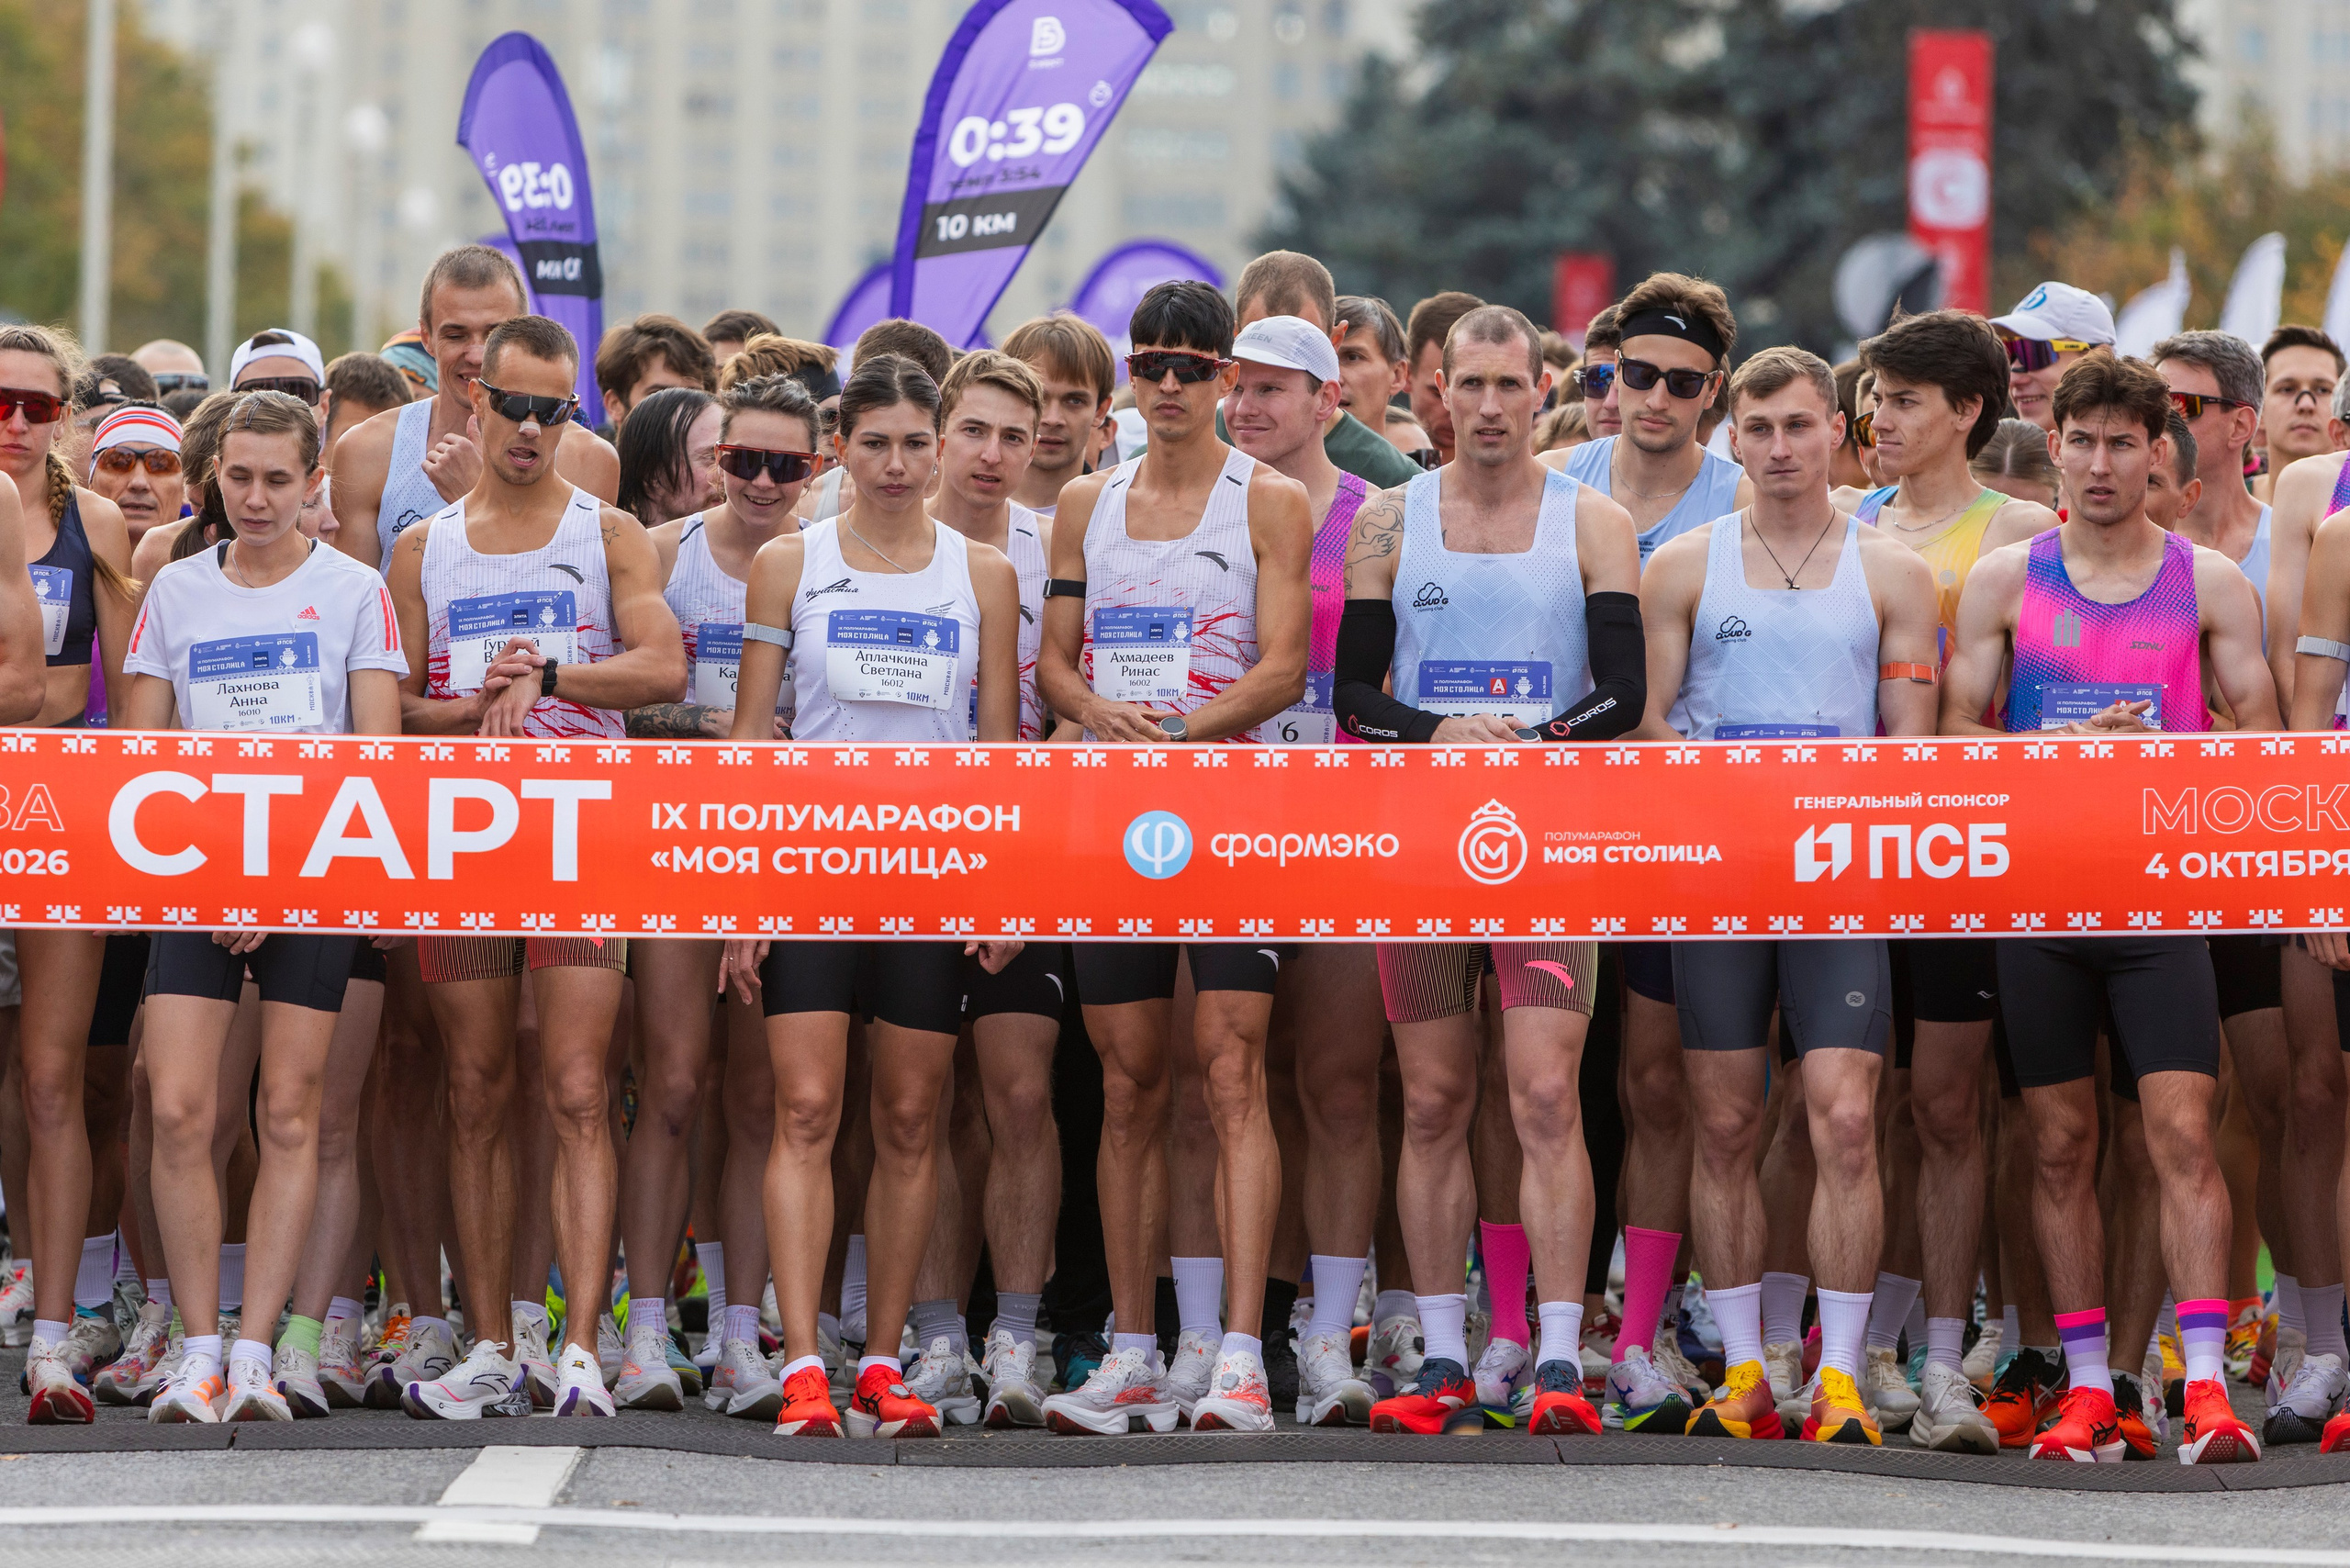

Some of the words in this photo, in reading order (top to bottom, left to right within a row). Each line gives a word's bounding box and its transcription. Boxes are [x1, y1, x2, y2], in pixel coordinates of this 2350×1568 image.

[948, 103, 1085, 168] 0:39
[936, 214, 968, 241] 10
[52, 620, 62, 643] МОСКВА
[458, 622, 473, 632] МОЯ
[474, 619, 505, 629] СТОЛИЦА
[854, 632, 890, 641] СТОЛИЦА
[706, 646, 721, 655] МОЯ
[855, 650, 928, 667] Аплачкина
[1110, 652, 1175, 664] Ахмадеев
[196, 663, 211, 673] МОЯ
[212, 661, 246, 671] СТОЛИЦА
[860, 664, 922, 679] Светлана
[1121, 666, 1160, 677] Ринас
[217, 681, 279, 695] Лахнова
[881, 678, 904, 688] 16012
[229, 696, 268, 708] Анна
[239, 709, 261, 717] 16010
[1567, 697, 1617, 727] COROS
[1359, 724, 1398, 738] COROS
[1794, 792, 1923, 809] ГЕНЕРАЛЬНЫЙ
[1928, 794, 2010, 807] СПОНСОР
[108, 771, 612, 881] СТАРТ
[652, 803, 687, 831] IX
[700, 804, 1020, 833] ПОЛУМАРАФОН
[1545, 831, 1640, 842] ПОЛУМАРАФОН
[1211, 833, 1400, 868] фармэко
[1543, 846, 1596, 863] МОЯ
[1603, 845, 1722, 865] СТОЛИЦА
[1869, 823, 2010, 879] ПСБ
[651, 846, 759, 874] «МОЯ
[773, 847, 988, 879] СТОЛИЦА»
[2145, 853, 2169, 879] 4
